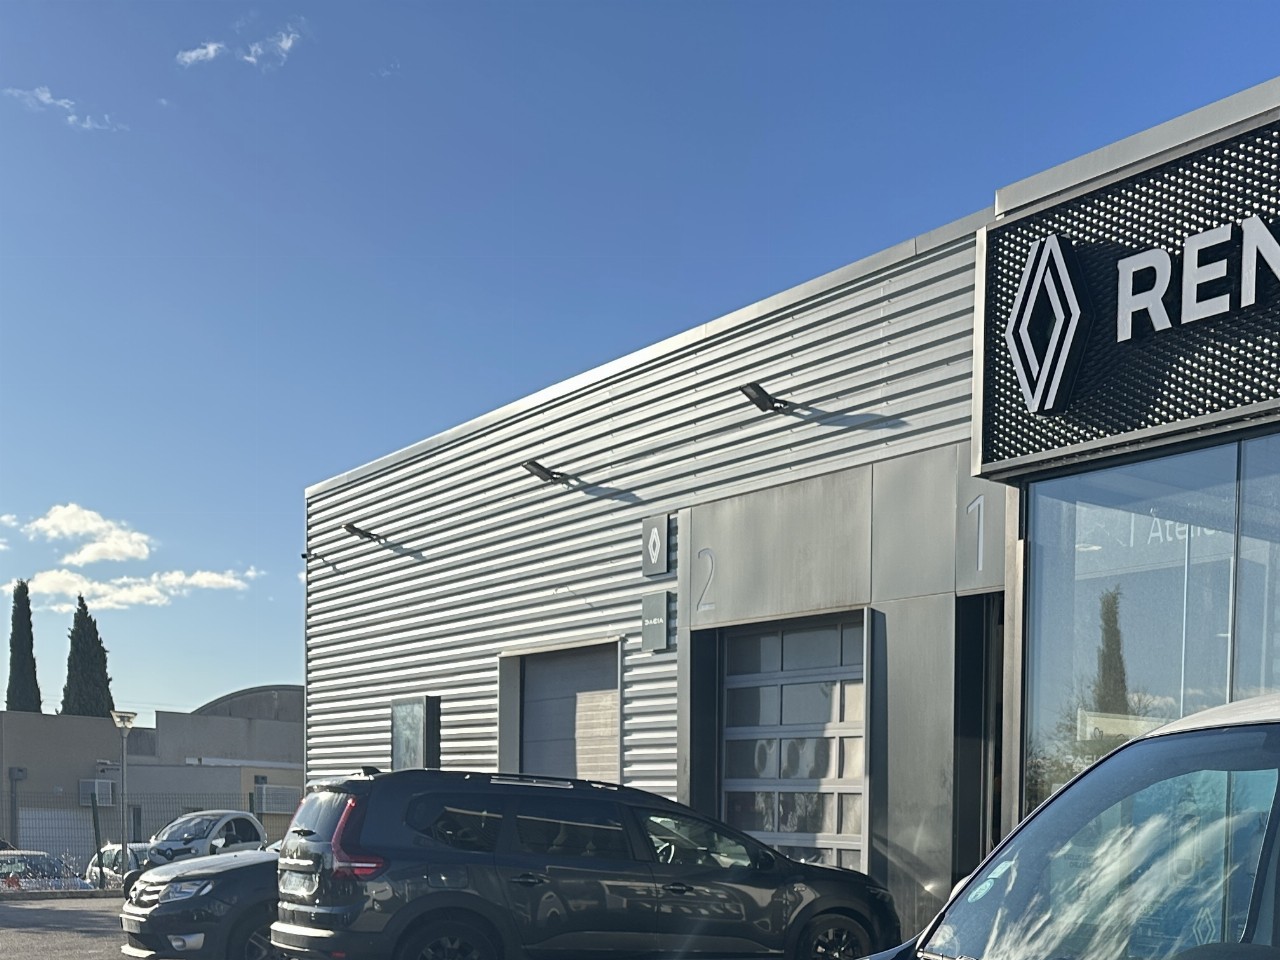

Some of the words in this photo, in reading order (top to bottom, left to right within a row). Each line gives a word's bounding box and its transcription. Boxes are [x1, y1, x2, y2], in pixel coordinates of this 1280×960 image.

[966, 493, 984, 571] 1
[696, 547, 716, 613] 2
[644, 617, 664, 626] DACIA
